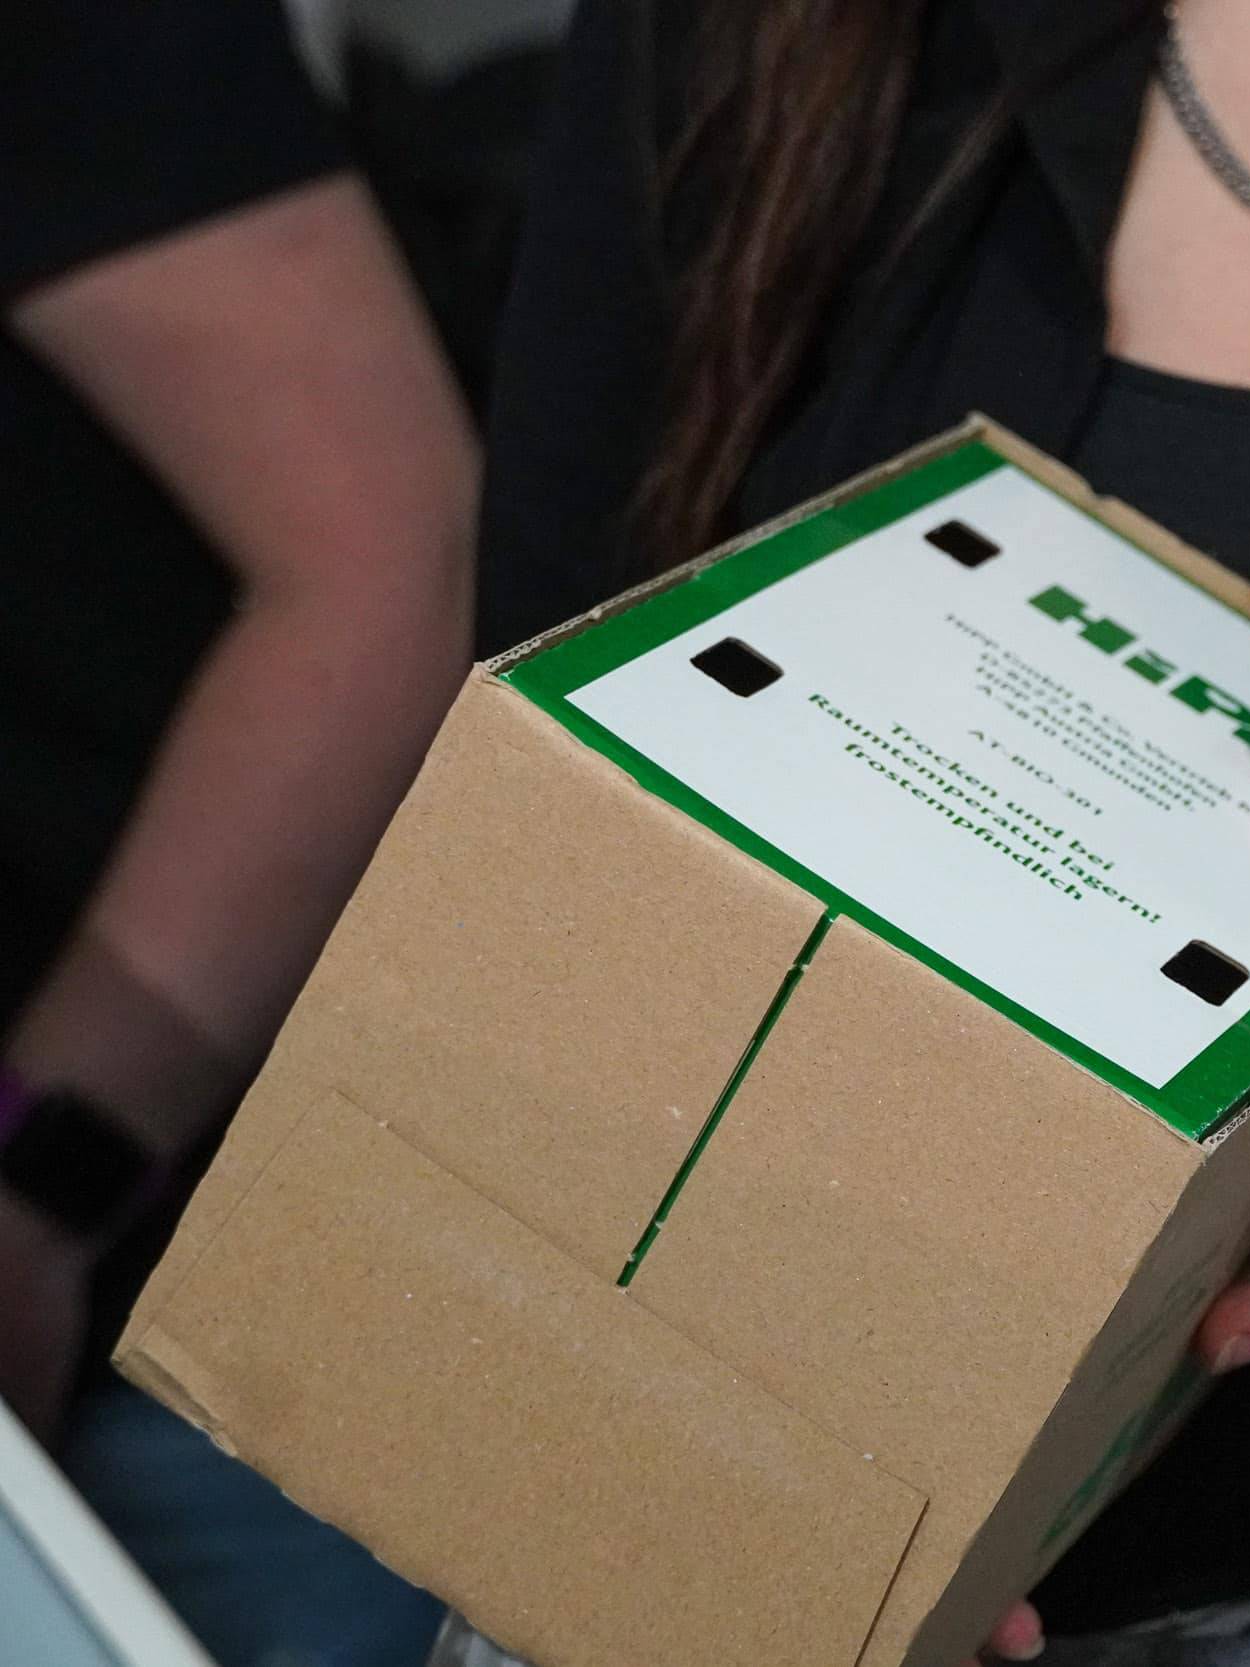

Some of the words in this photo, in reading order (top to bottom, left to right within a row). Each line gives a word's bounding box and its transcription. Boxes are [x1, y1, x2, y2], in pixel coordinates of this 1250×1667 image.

[967, 729, 1103, 816] AT-BIO-301
[1033, 705, 1113, 759] Austria
[1062, 737, 1172, 812] Gmunden
[808, 693, 1056, 855] Raumtemperatur
[1059, 856, 1162, 925] lagern!
[844, 742, 1084, 902] frostempfindlich
[891, 721, 998, 799] Trocken
[1005, 801, 1064, 839] und
[1068, 840, 1115, 871] bei
